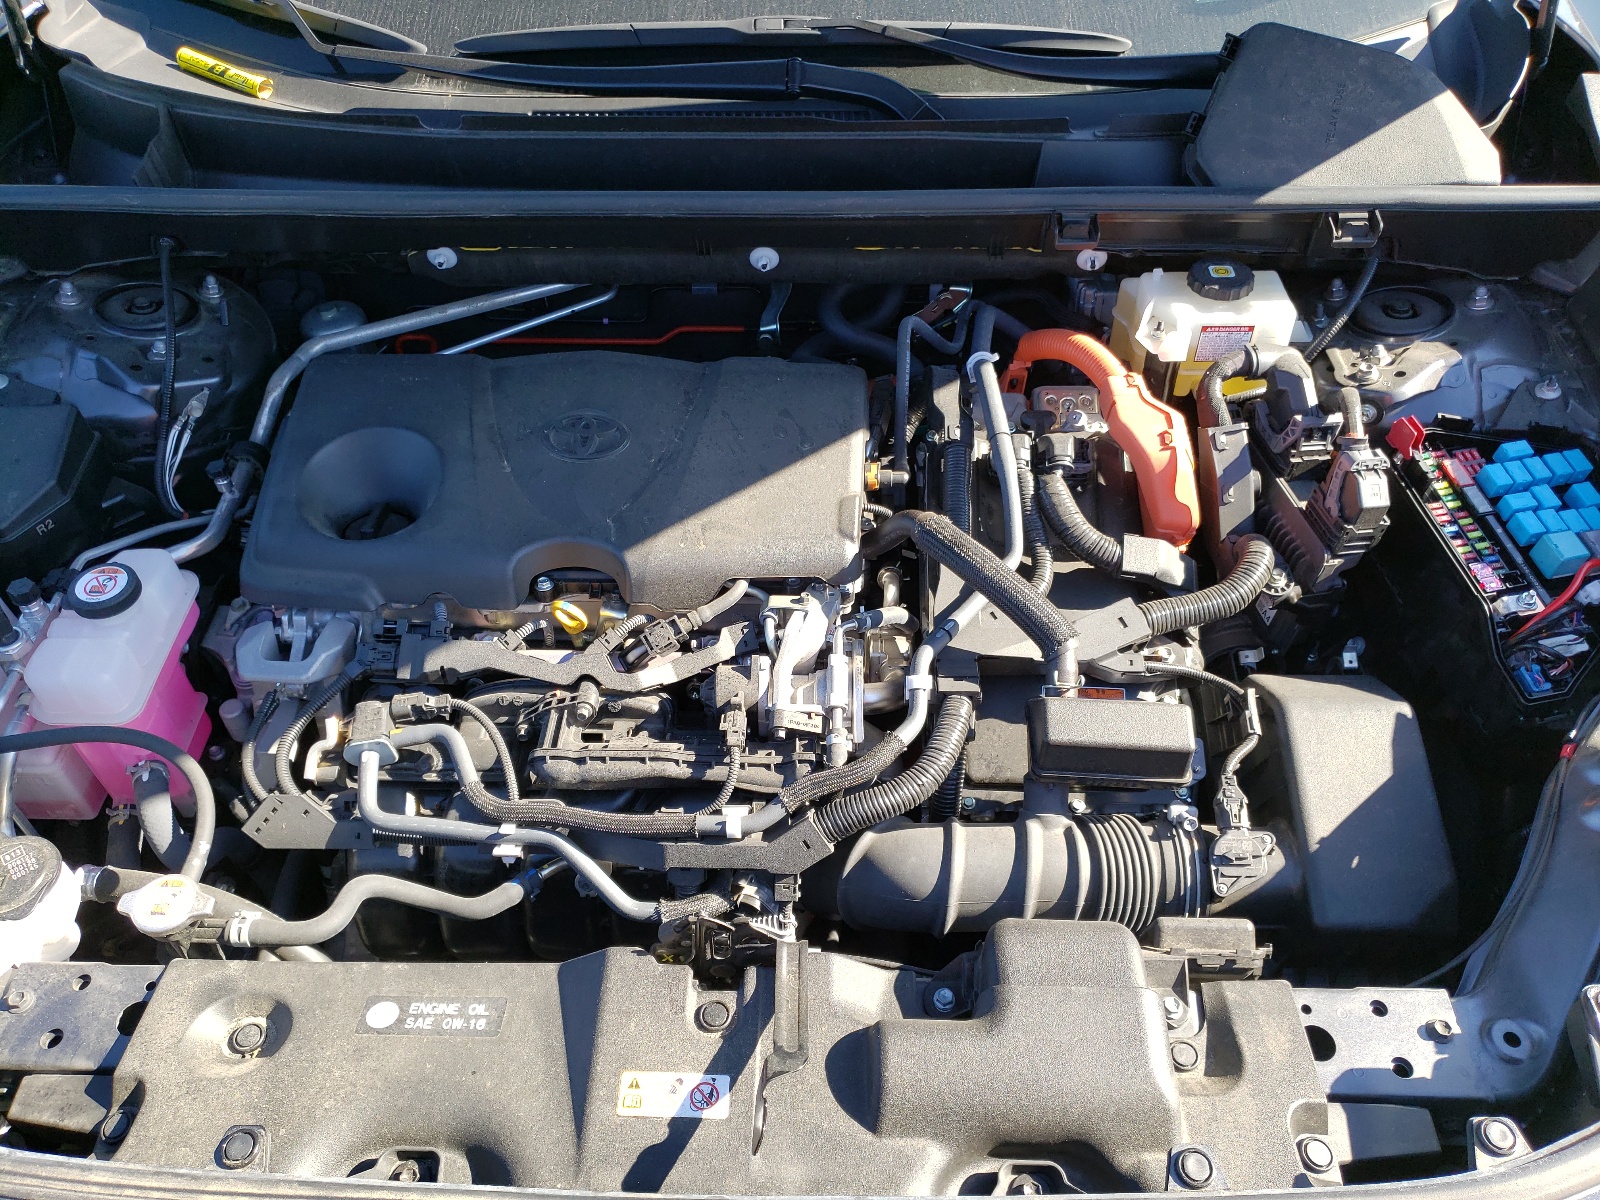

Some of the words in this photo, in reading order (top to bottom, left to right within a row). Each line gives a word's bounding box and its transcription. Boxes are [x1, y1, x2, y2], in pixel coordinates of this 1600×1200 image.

[36, 519, 55, 535] R2
[409, 1002, 461, 1015] ENGINE
[468, 1003, 490, 1016] OIL
[404, 1017, 434, 1030] SAE
[442, 1018, 487, 1031] 0W-16
